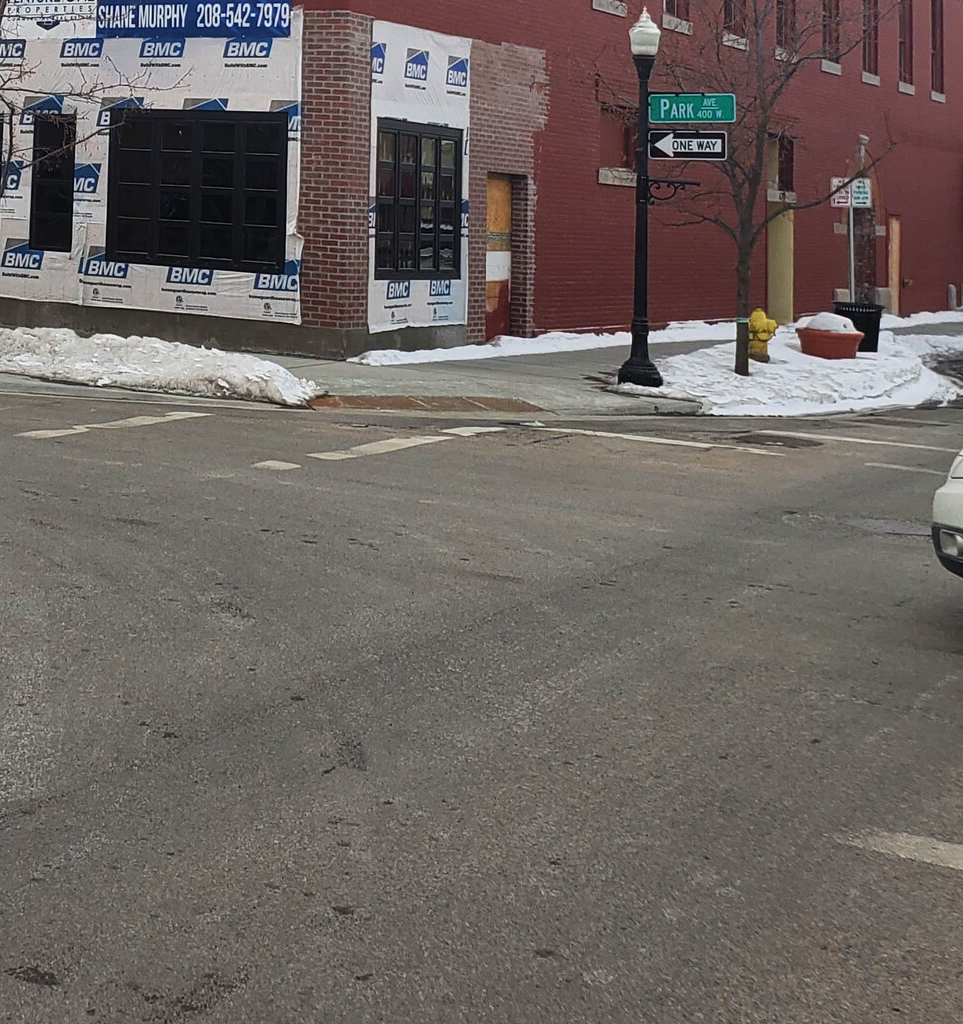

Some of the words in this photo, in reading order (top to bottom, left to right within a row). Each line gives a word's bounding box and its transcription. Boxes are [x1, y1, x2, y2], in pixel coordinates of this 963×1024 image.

[7, 6, 92, 14] PROPERTIES
[98, 4, 135, 29] SHANE
[139, 4, 188, 28] MURPHY
[197, 3, 290, 28] 208-542-7979
[63, 43, 99, 56] BMC
[143, 42, 181, 56] BMC
[227, 42, 268, 56] BMC
[406, 62, 426, 79] BMC
[448, 70, 466, 86] BMC
[660, 98, 694, 119] PARK
[697, 110, 712, 118] 400
[672, 140, 693, 151] ONE
[697, 140, 717, 151] WAY
[74, 177, 95, 192] MC
[4, 252, 39, 268] BMC
[88, 260, 125, 276] BMC
[170, 267, 209, 283] BMC
[258, 274, 298, 290] BMC
[388, 281, 409, 298] BMC
[431, 280, 450, 295] BMC
